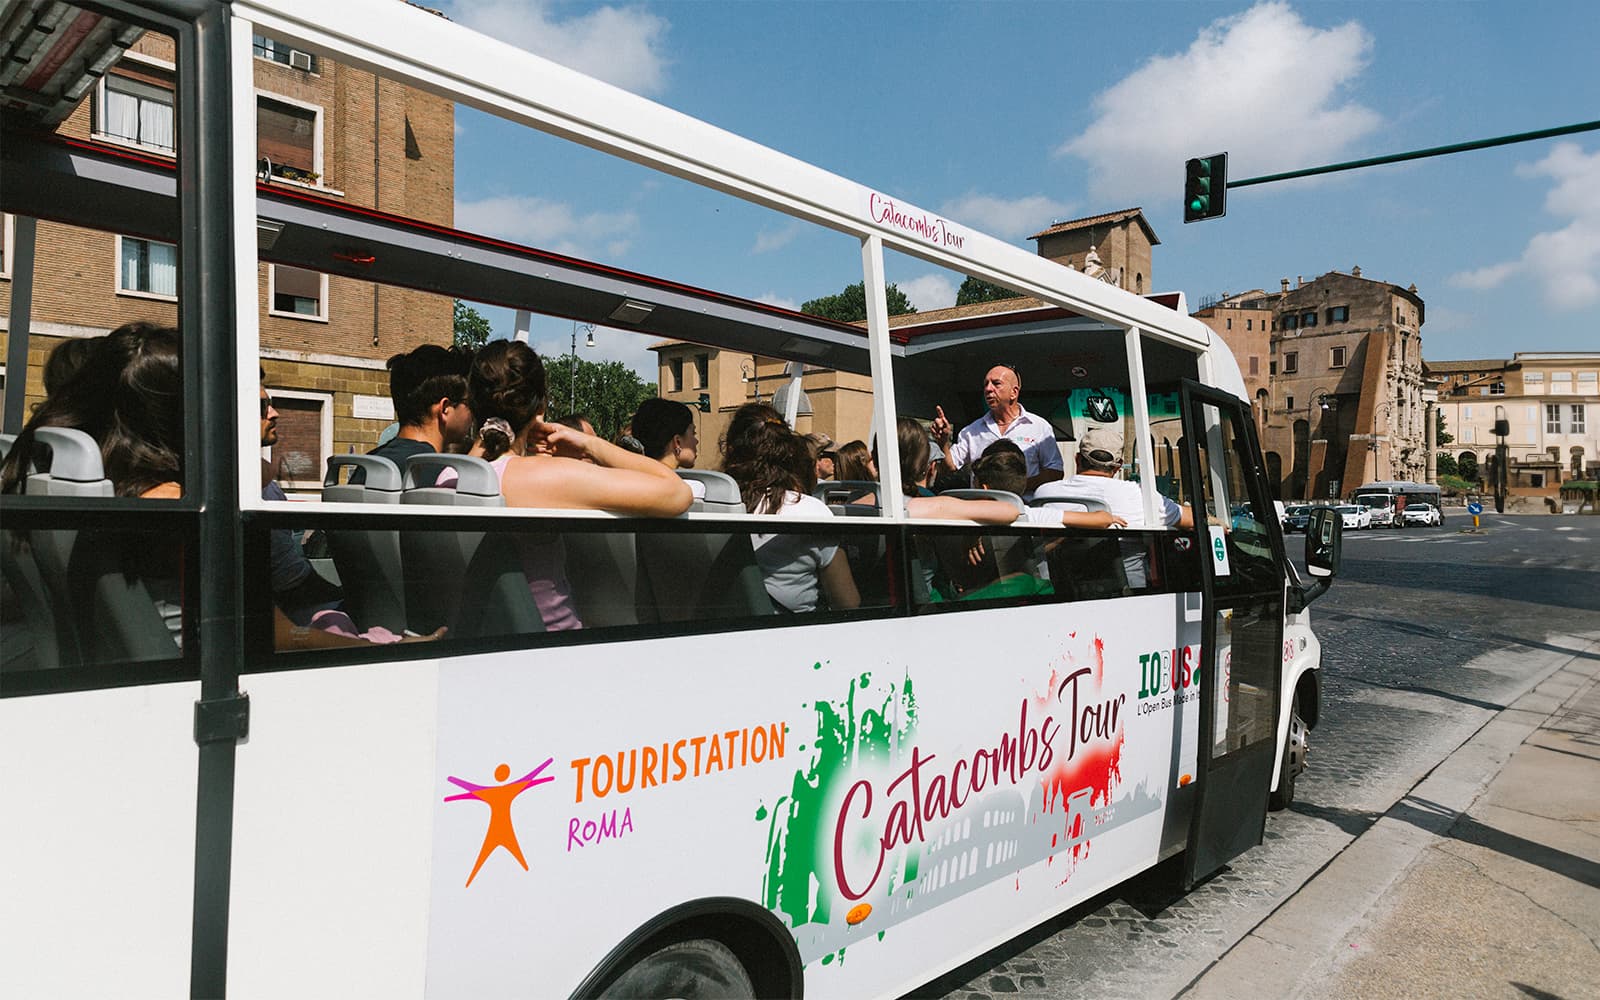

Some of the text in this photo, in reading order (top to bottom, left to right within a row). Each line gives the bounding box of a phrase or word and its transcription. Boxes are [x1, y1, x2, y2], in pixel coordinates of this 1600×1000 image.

[870, 193, 965, 249] Catacombs Tour
[1138, 645, 1192, 699] IOBUS
[1137, 702, 1160, 716] L'Open
[1161, 698, 1172, 709] Bus
[1174, 693, 1189, 705] Made
[570, 721, 786, 803] TOURISTATION
[834, 667, 1126, 900] Catacombs Tour
